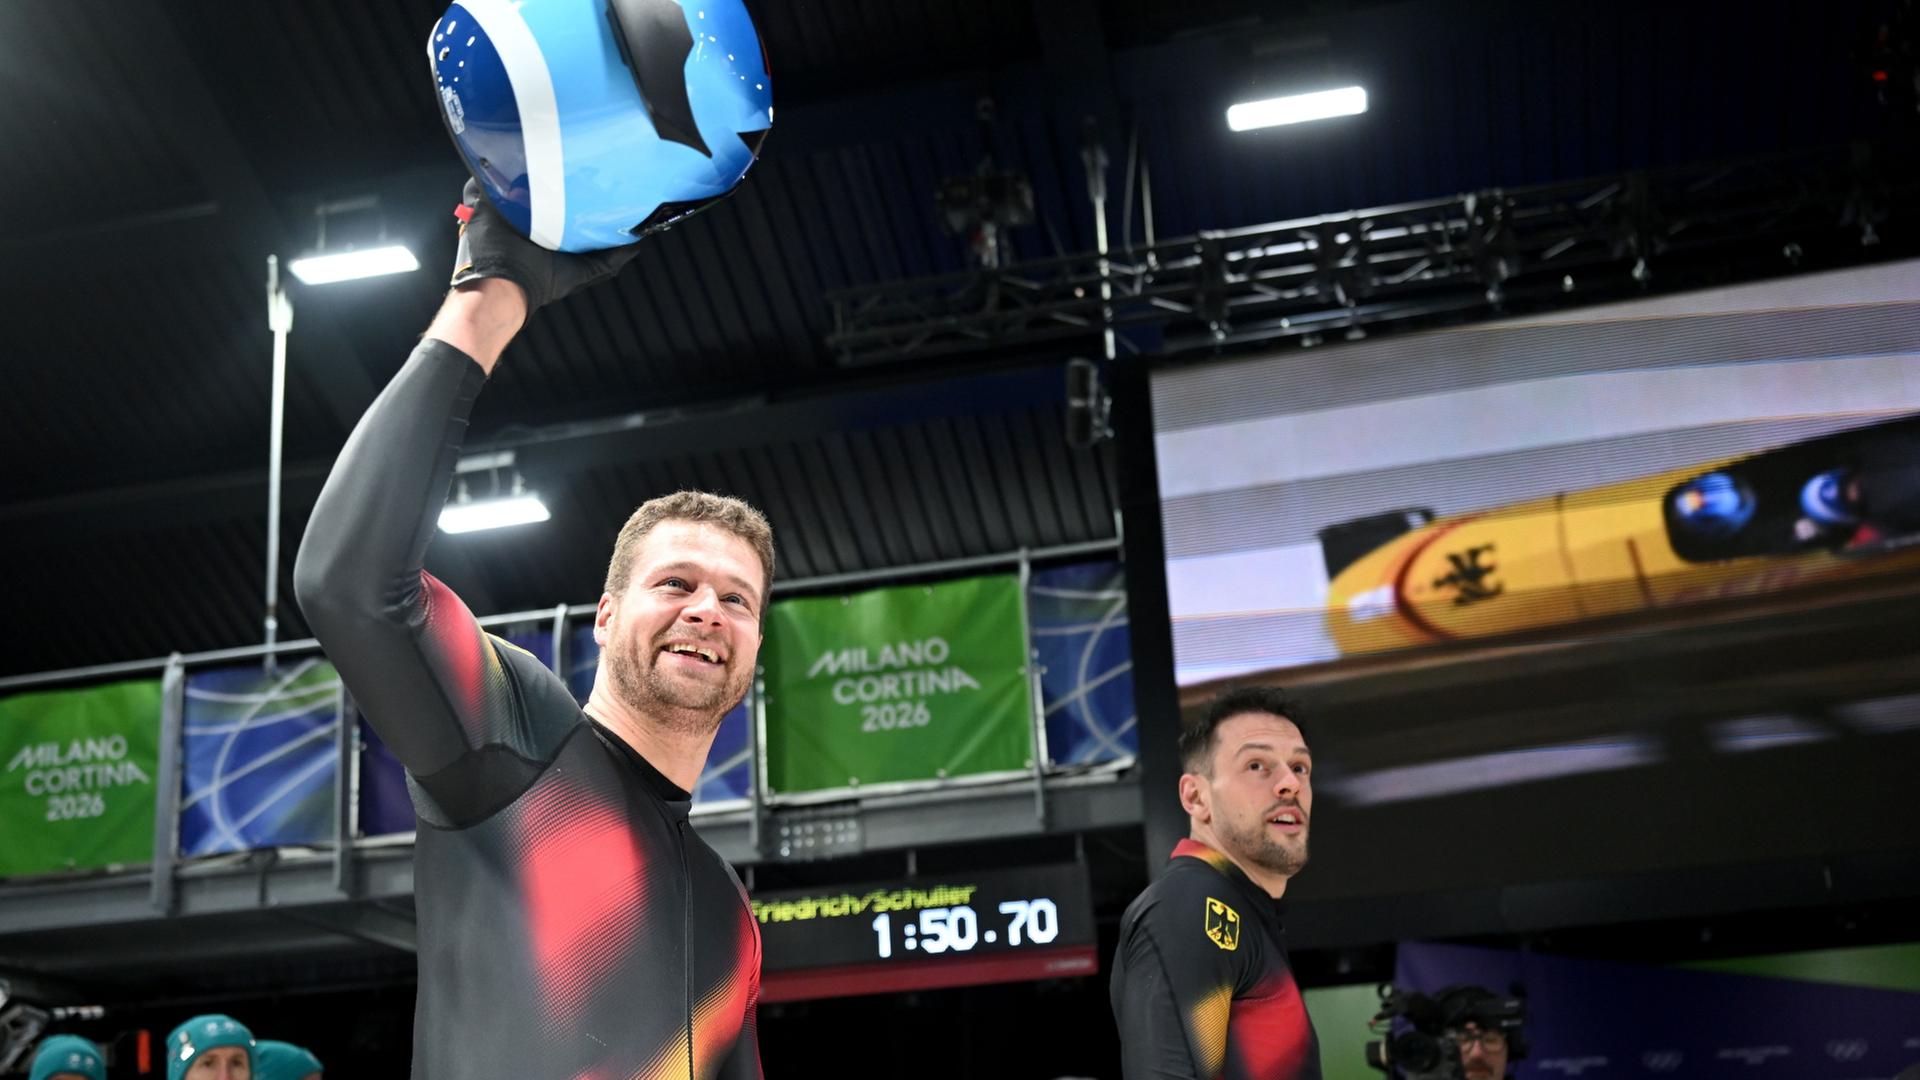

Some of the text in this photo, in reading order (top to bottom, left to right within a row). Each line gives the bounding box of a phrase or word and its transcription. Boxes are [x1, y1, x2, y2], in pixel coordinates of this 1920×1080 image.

[808, 637, 949, 677] MILANO
[832, 667, 980, 704] CORTINA
[861, 701, 931, 732] 2026
[7, 735, 127, 772] MILANO
[25, 761, 149, 795] CORTINA
[46, 793, 105, 821] 2026
[872, 898, 1058, 957] 1:50.70
